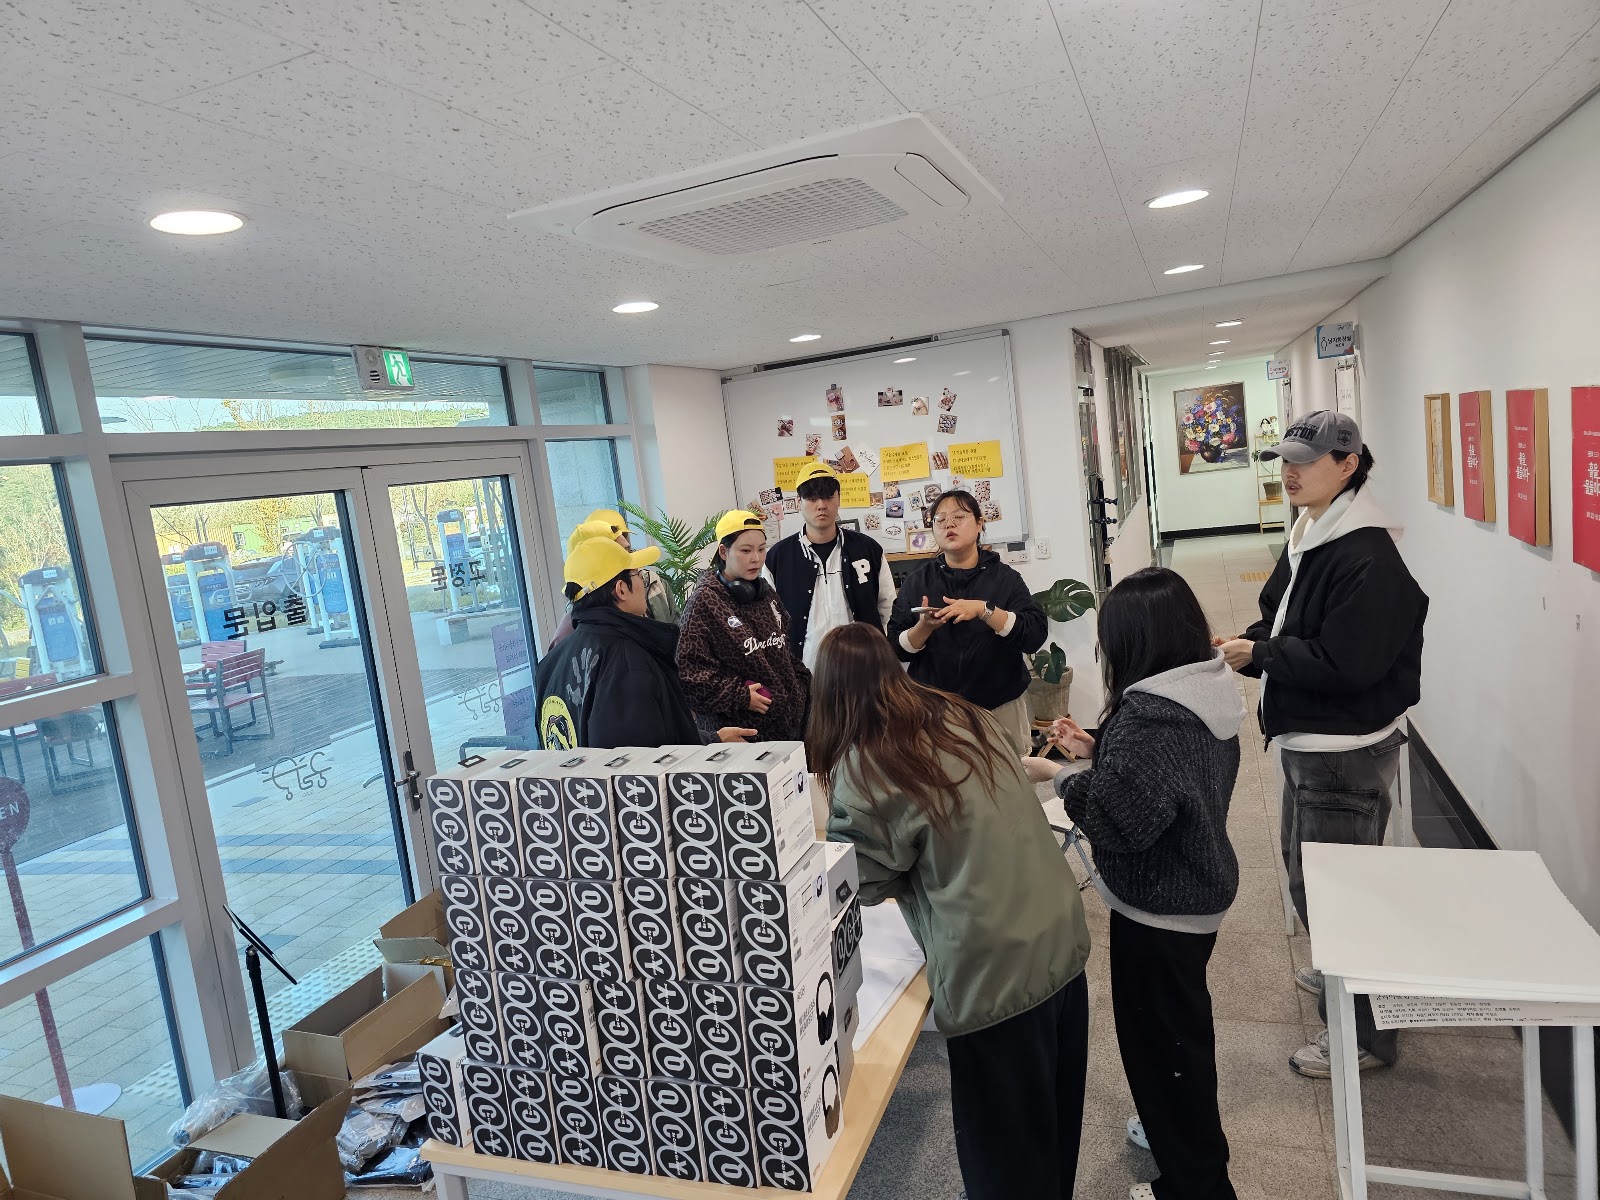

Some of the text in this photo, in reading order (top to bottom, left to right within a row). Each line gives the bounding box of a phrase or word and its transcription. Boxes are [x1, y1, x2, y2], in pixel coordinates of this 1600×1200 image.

[851, 558, 871, 585] P
[427, 779, 474, 875] QCY
[470, 780, 520, 877] QCY
[519, 778, 566, 879] QCY
[563, 778, 613, 880] QCY
[614, 775, 666, 879] QCY
[668, 774, 722, 879] QCY
[718, 774, 776, 881] QCY
[441, 875, 489, 971] QCY
[484, 876, 535, 974] QCY
[525, 881, 577, 980] QCY
[571, 882, 622, 982] QCY
[624, 878, 676, 981] QCY
[678, 878, 731, 983] QCY
[738, 881, 790, 989] QCY
[456, 969, 502, 1064] QCY
[499, 973, 547, 1070] QCY
[538, 980, 589, 1079] QCY
[593, 979, 645, 1078] QCY
[645, 979, 696, 1080] QCY
[692, 983, 744, 1087] QCY
[745, 987, 797, 1094] QCY
[418, 1053, 460, 1147] QCY
[464, 1064, 512, 1158] QCY
[505, 1069, 556, 1164] QCY
[551, 1073, 602, 1167] QCY
[598, 1076, 650, 1175] QCY
[647, 1081, 700, 1182] QCY
[699, 1085, 754, 1188] QCY
[753, 1087, 808, 1192] QCY
